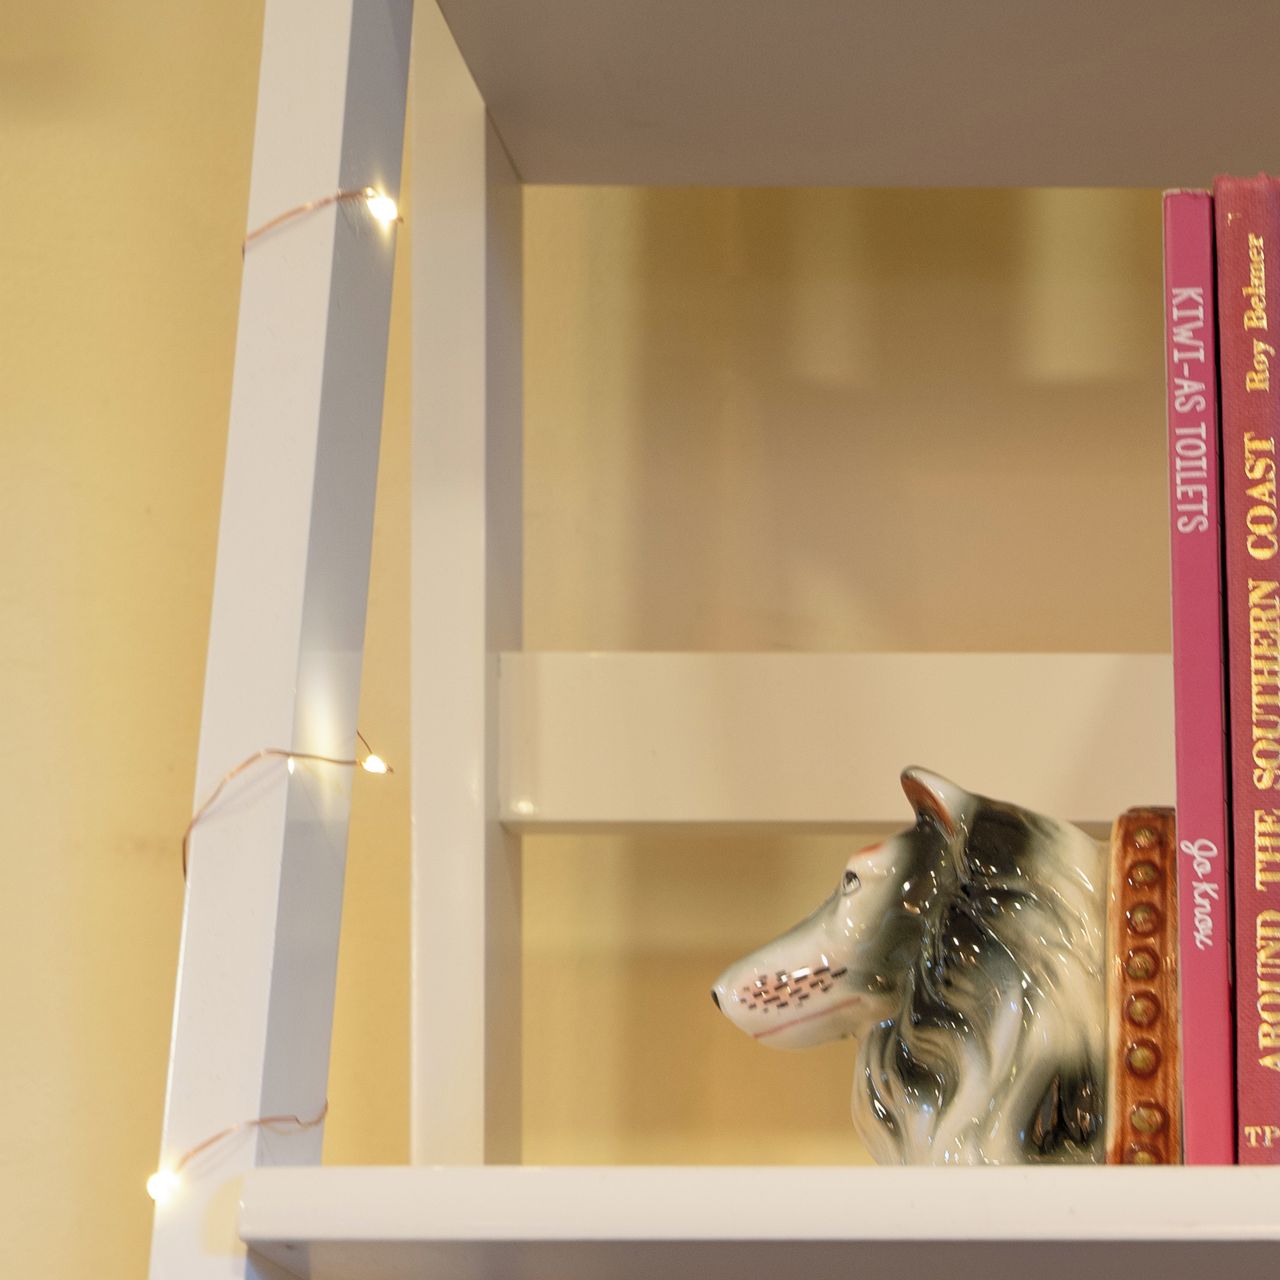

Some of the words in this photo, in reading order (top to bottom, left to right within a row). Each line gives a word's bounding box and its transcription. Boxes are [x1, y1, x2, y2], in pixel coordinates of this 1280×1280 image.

[1172, 287, 1206, 414] KIWI-AS
[1246, 340, 1276, 393] Roy
[1174, 423, 1209, 534] TOILETS
[1243, 431, 1279, 560] COAST
[1180, 837, 1219, 879] Jo
[1192, 880, 1220, 951] Knox
